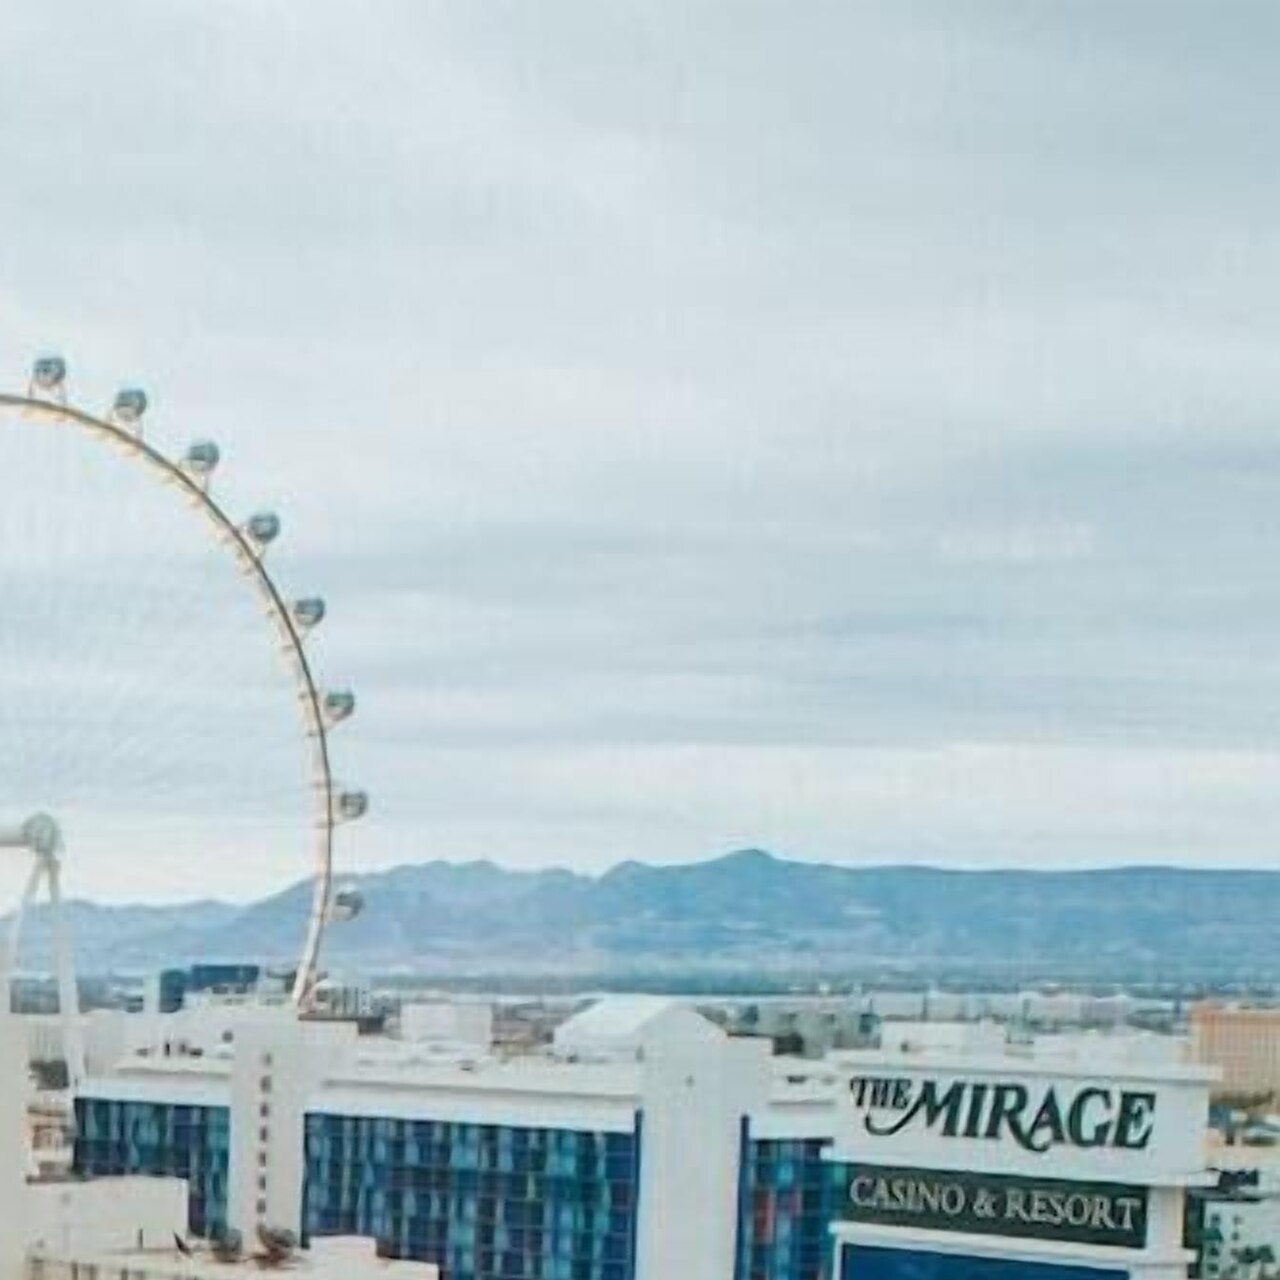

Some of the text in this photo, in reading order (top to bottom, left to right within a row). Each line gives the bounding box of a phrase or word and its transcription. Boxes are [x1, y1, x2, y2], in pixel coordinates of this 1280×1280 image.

[850, 1076, 1157, 1152] THE MIRAGE
[850, 1176, 1143, 1230] CASINO & RESORT
